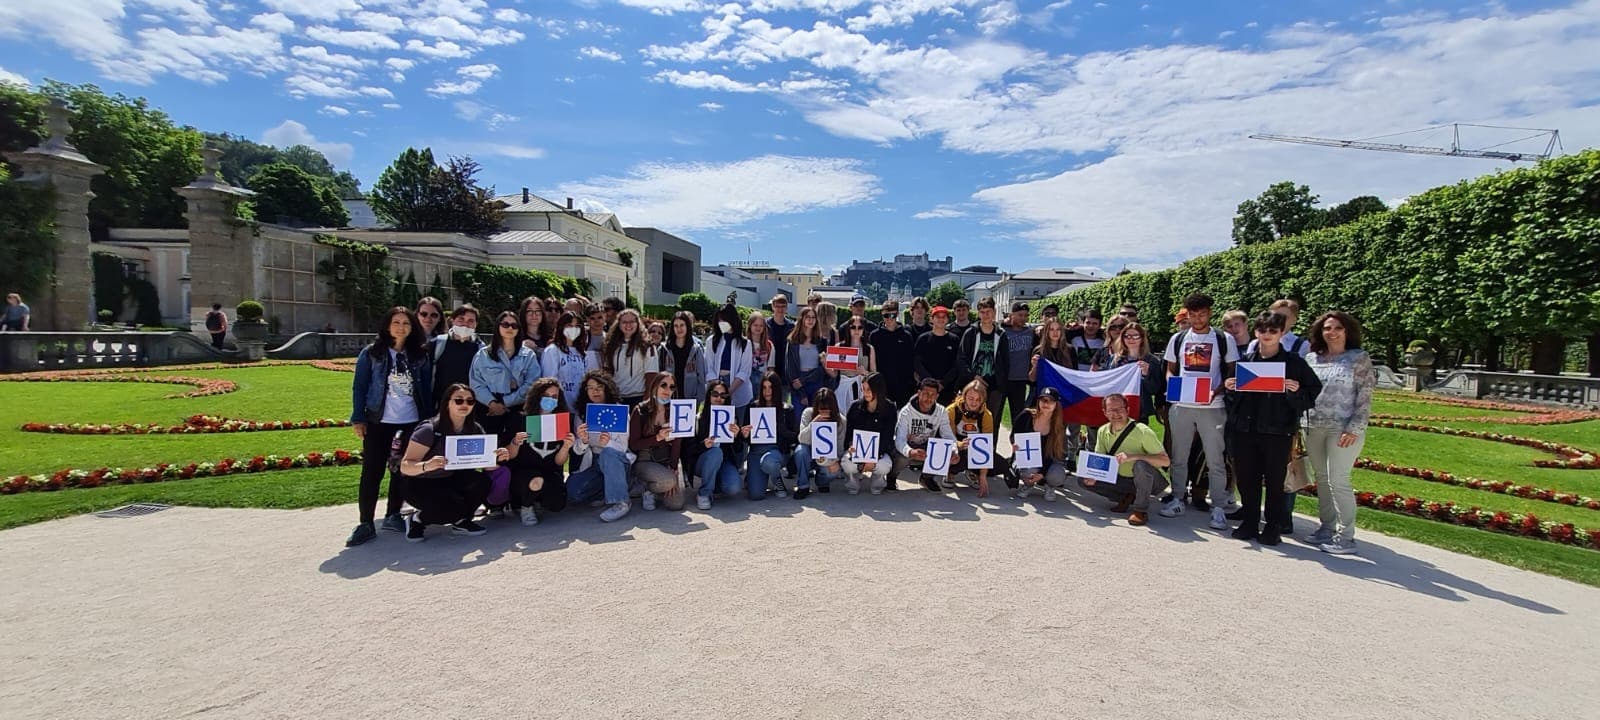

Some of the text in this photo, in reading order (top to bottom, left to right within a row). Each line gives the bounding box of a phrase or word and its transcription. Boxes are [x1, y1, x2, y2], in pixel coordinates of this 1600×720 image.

[672, 403, 693, 434] E
[712, 408, 733, 439] R
[752, 412, 775, 439] A
[816, 425, 833, 456] S
[854, 433, 878, 460] M
[928, 441, 951, 471] U
[971, 436, 990, 465] S
